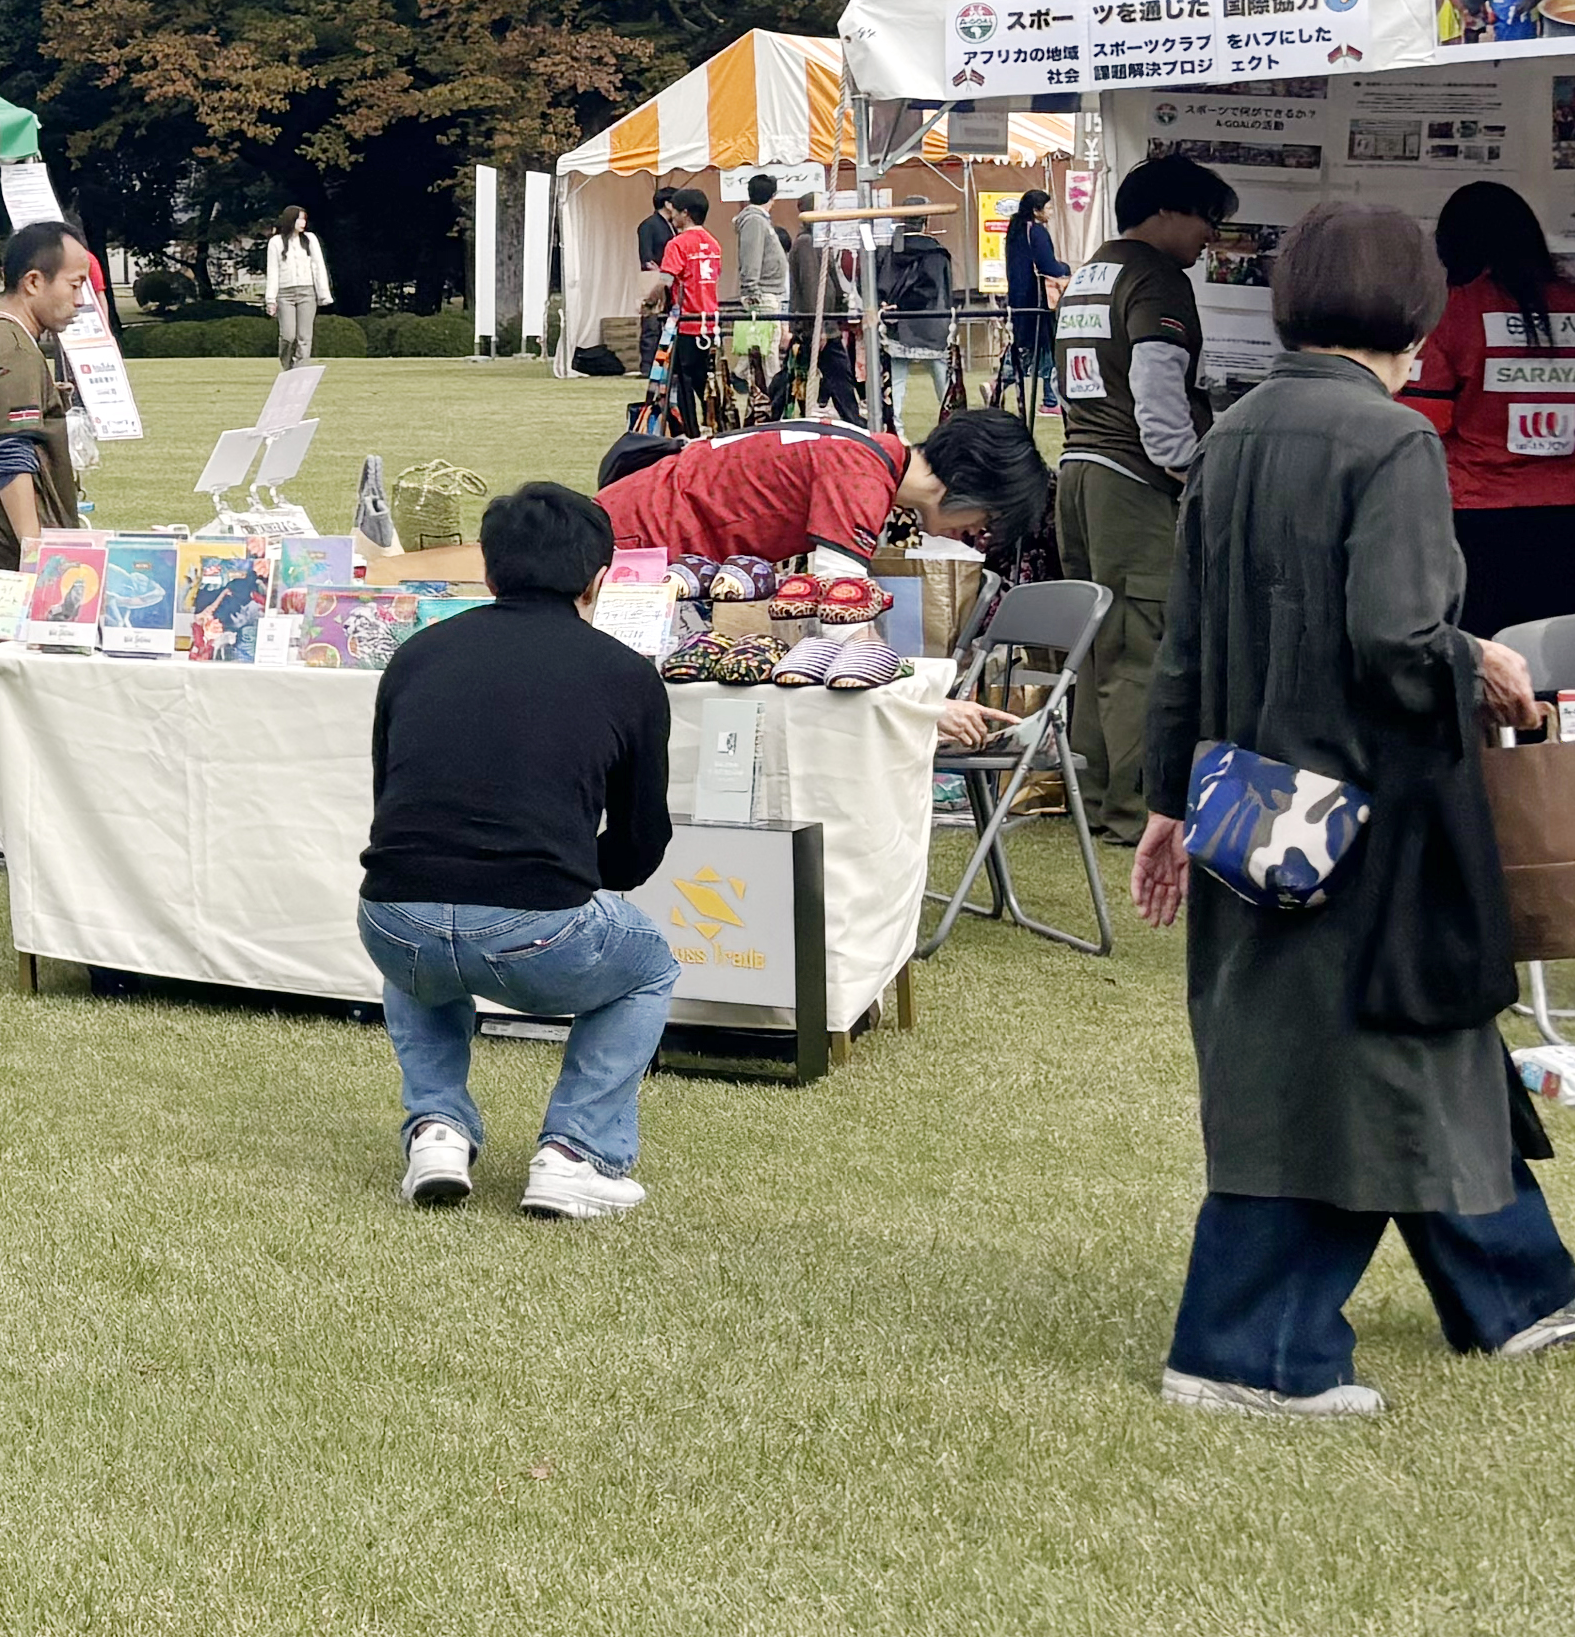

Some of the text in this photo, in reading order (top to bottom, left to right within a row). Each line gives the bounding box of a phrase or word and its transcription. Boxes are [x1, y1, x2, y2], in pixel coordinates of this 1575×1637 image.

[963, 45, 1080, 65] アフリカの地域
[1094, 35, 1212, 57] スポーツクラブ
[1047, 68, 1080, 85] 社会
[1497, 367, 1575, 383] SARAY
